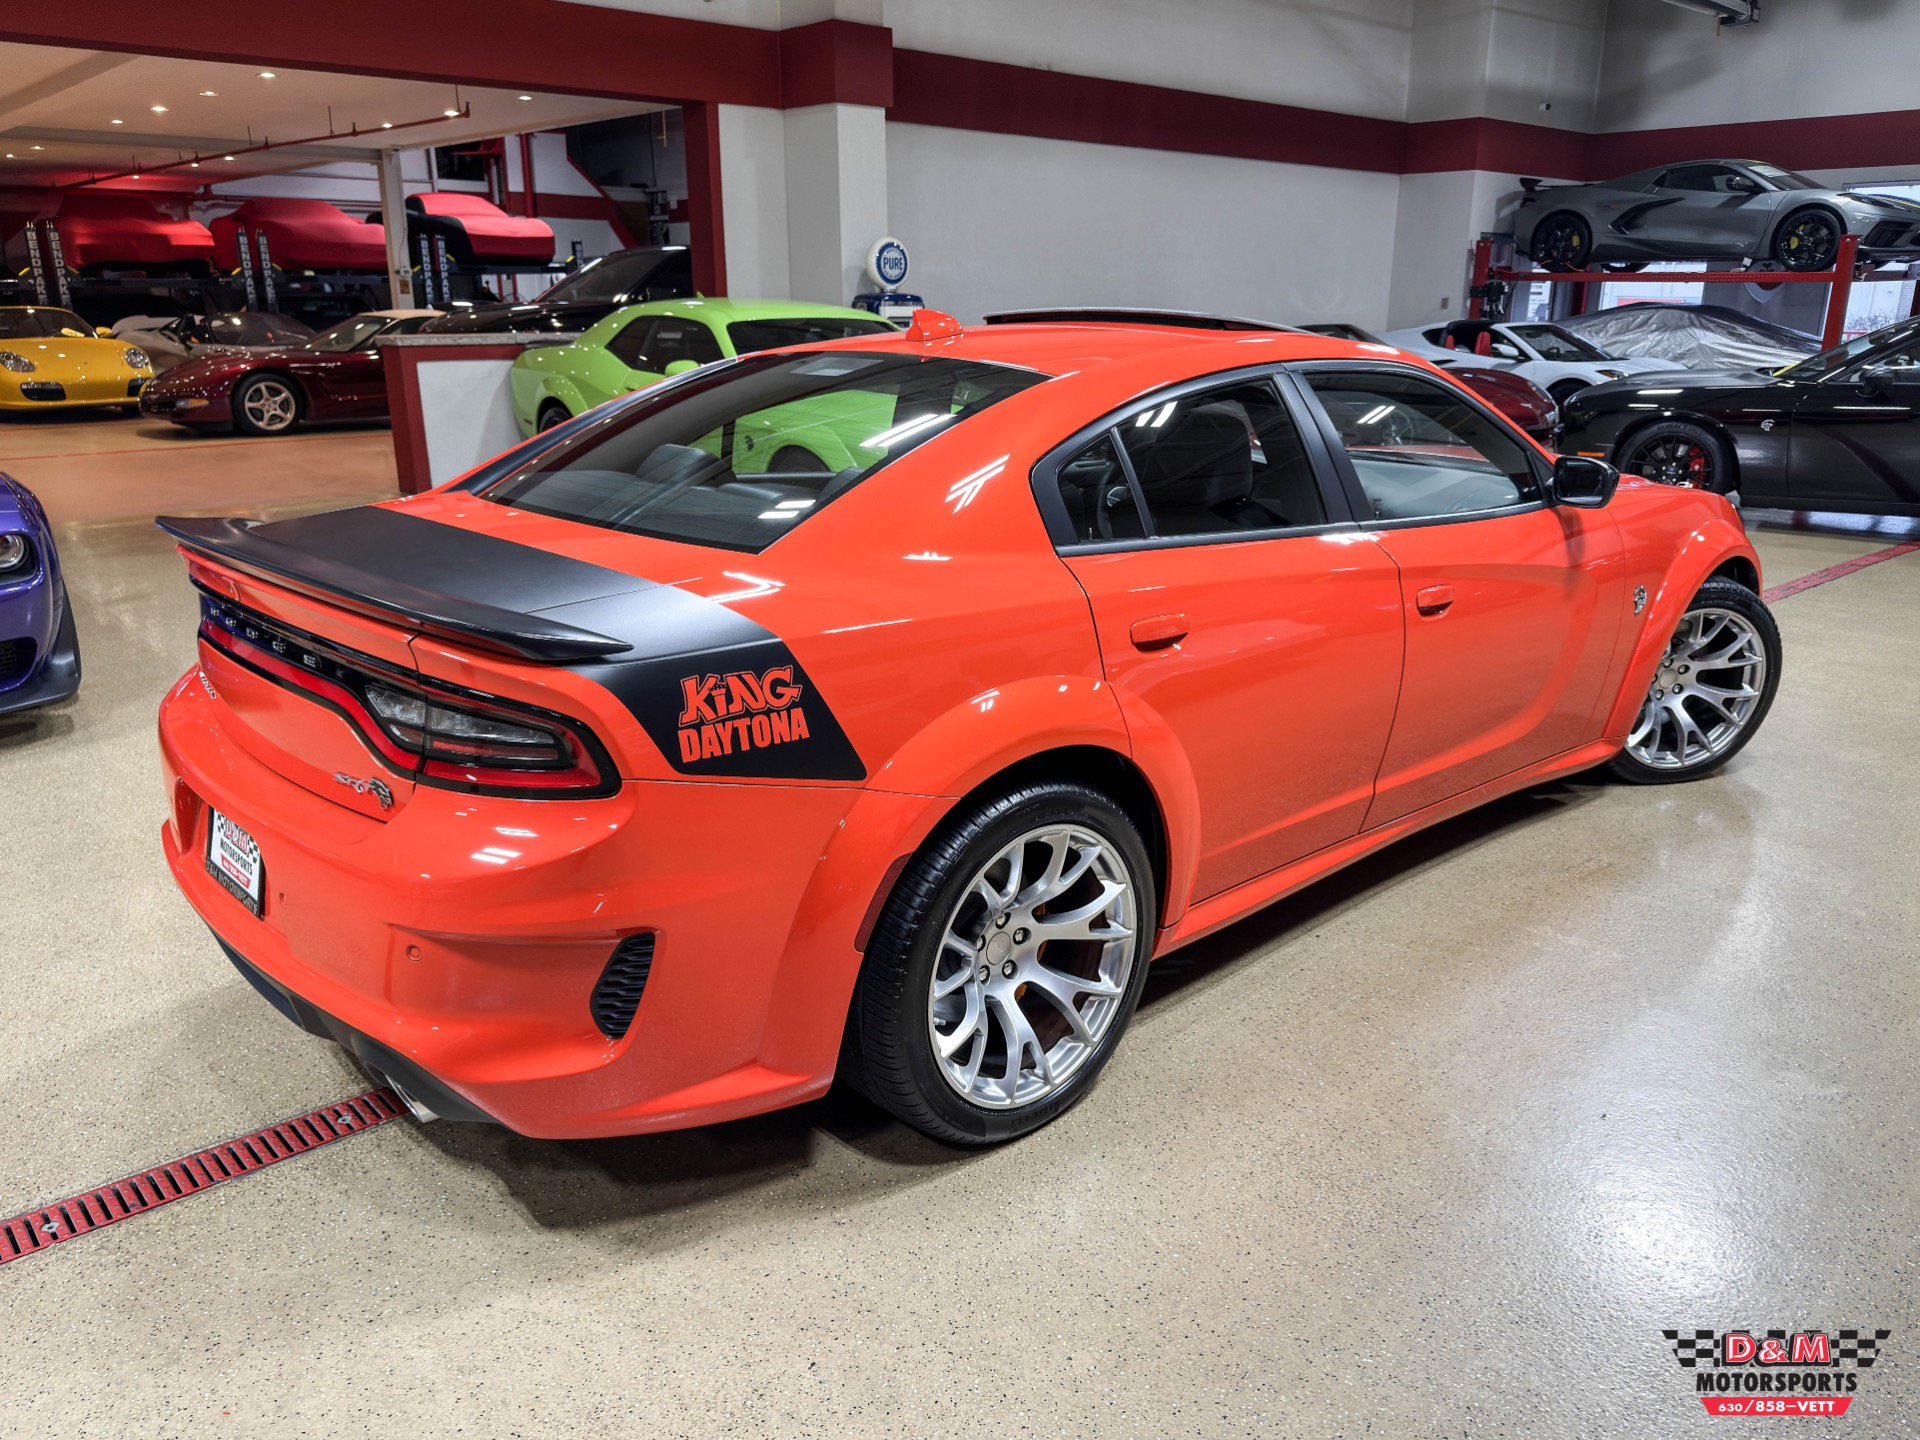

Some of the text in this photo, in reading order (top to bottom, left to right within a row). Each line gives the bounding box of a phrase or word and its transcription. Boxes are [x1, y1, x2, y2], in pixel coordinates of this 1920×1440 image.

[883, 257, 903, 270] PURE
[677, 707, 810, 763] DAYTONA
[220, 838, 253, 876] MOTORSPORTS
